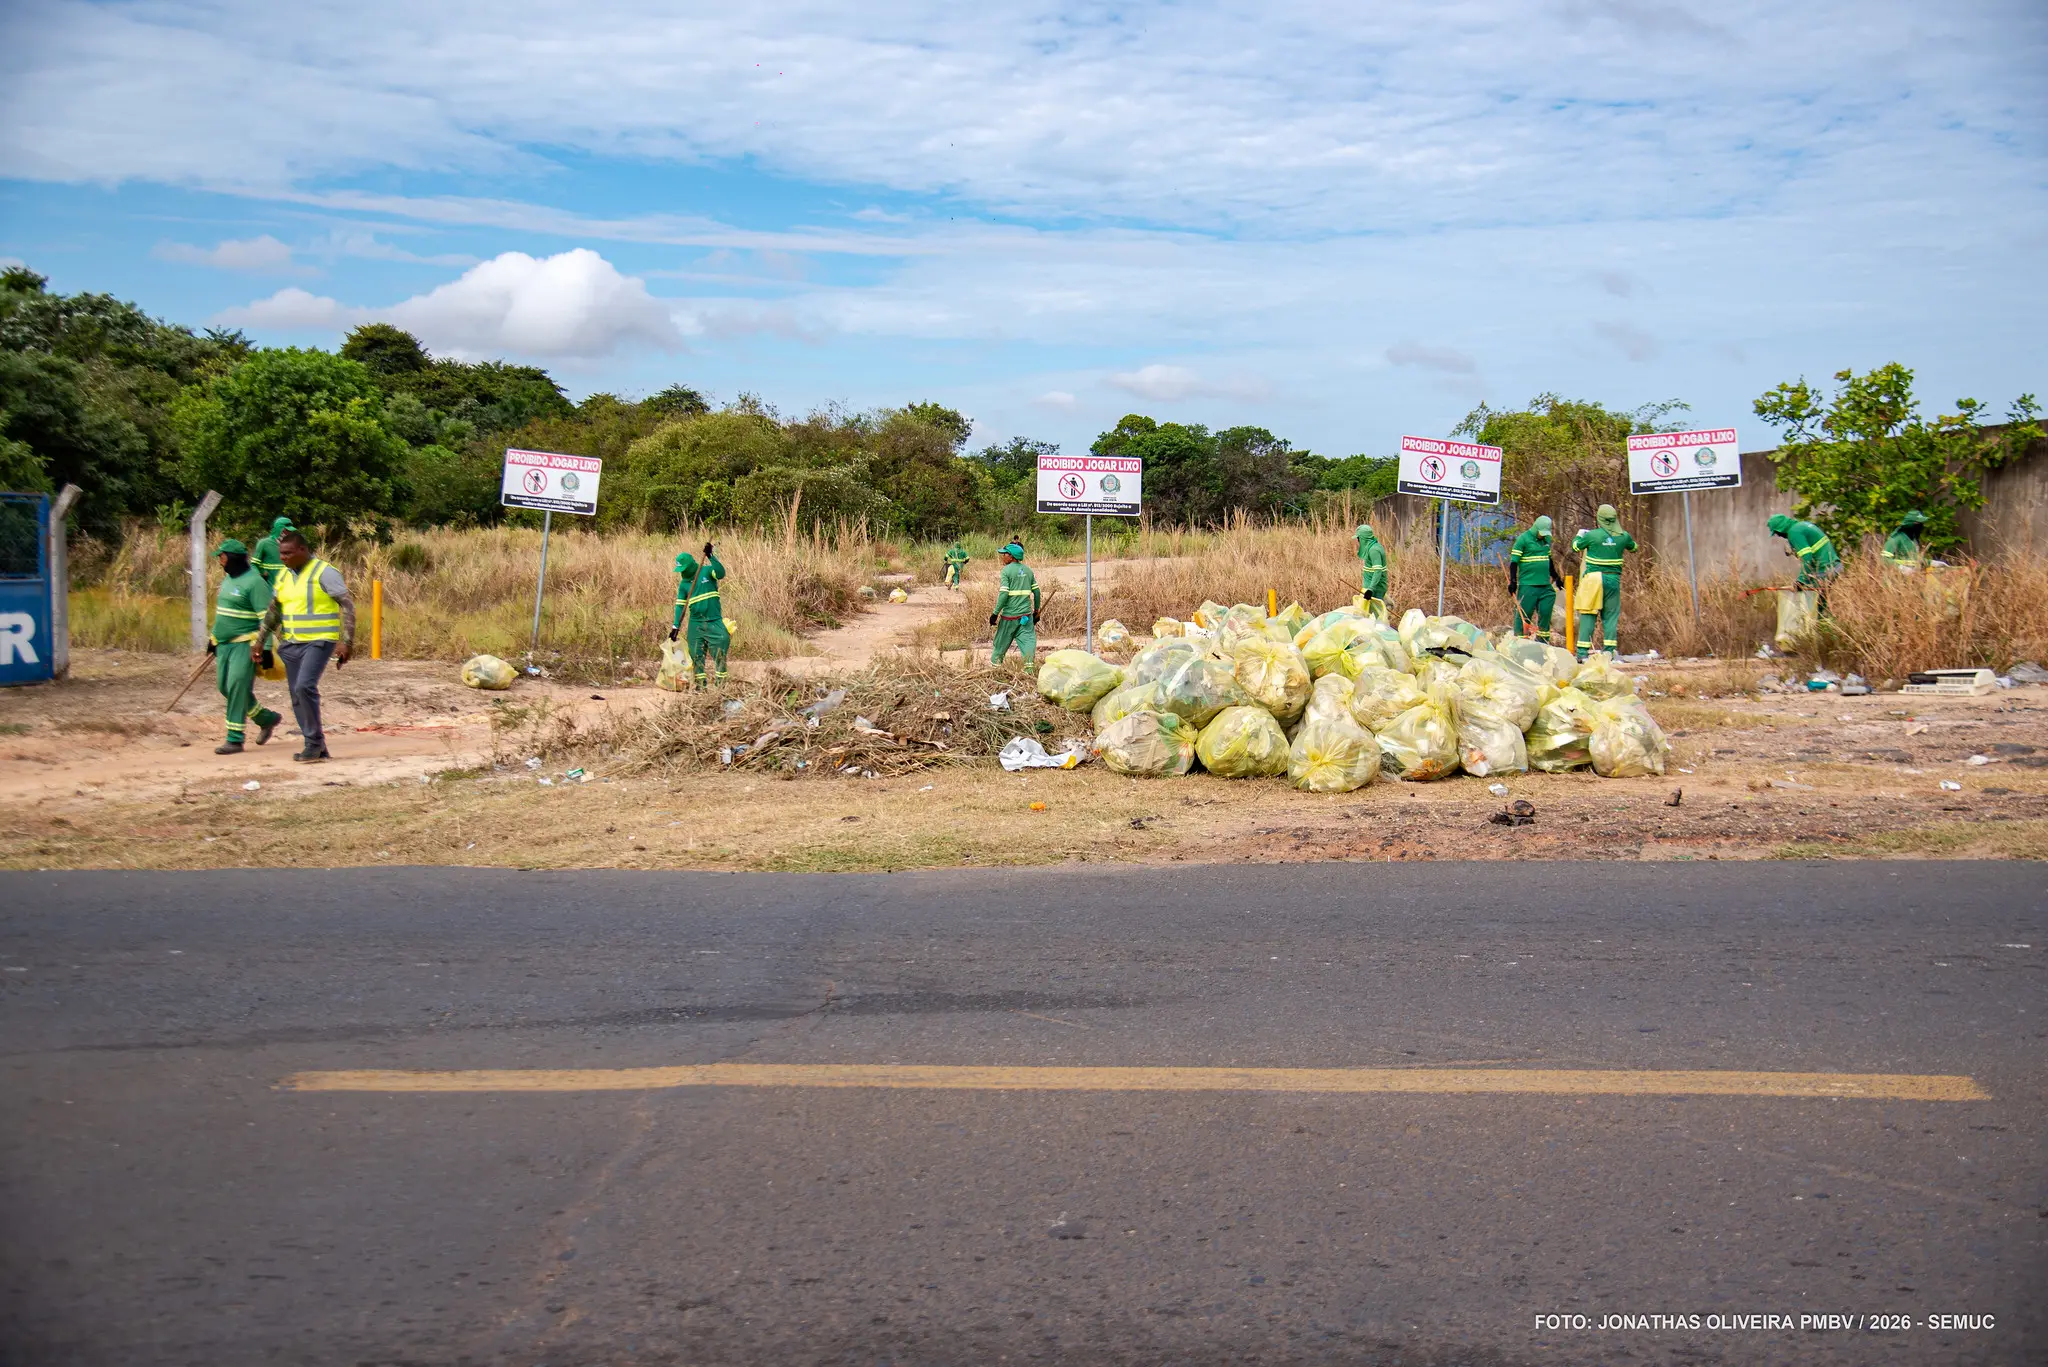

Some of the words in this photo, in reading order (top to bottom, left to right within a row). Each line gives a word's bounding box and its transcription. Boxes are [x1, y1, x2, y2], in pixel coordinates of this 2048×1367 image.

[1403, 438, 1446, 454] PROIBIDO
[1447, 444, 1478, 457] JOGAR
[1479, 447, 1499, 460] LIXO
[1629, 436, 1675, 449] PROIBIDO
[1676, 432, 1711, 445] JOGAR
[1711, 430, 1735, 442] LIXO
[509, 452, 549, 467] PROIBIDO
[549, 456, 579, 470] JOGAR
[579, 460, 599, 471] LIXO
[1040, 458, 1084, 470] PROIBIDO
[1085, 460, 1117, 471] JOGAR
[1118, 460, 1139, 471] LIXO
